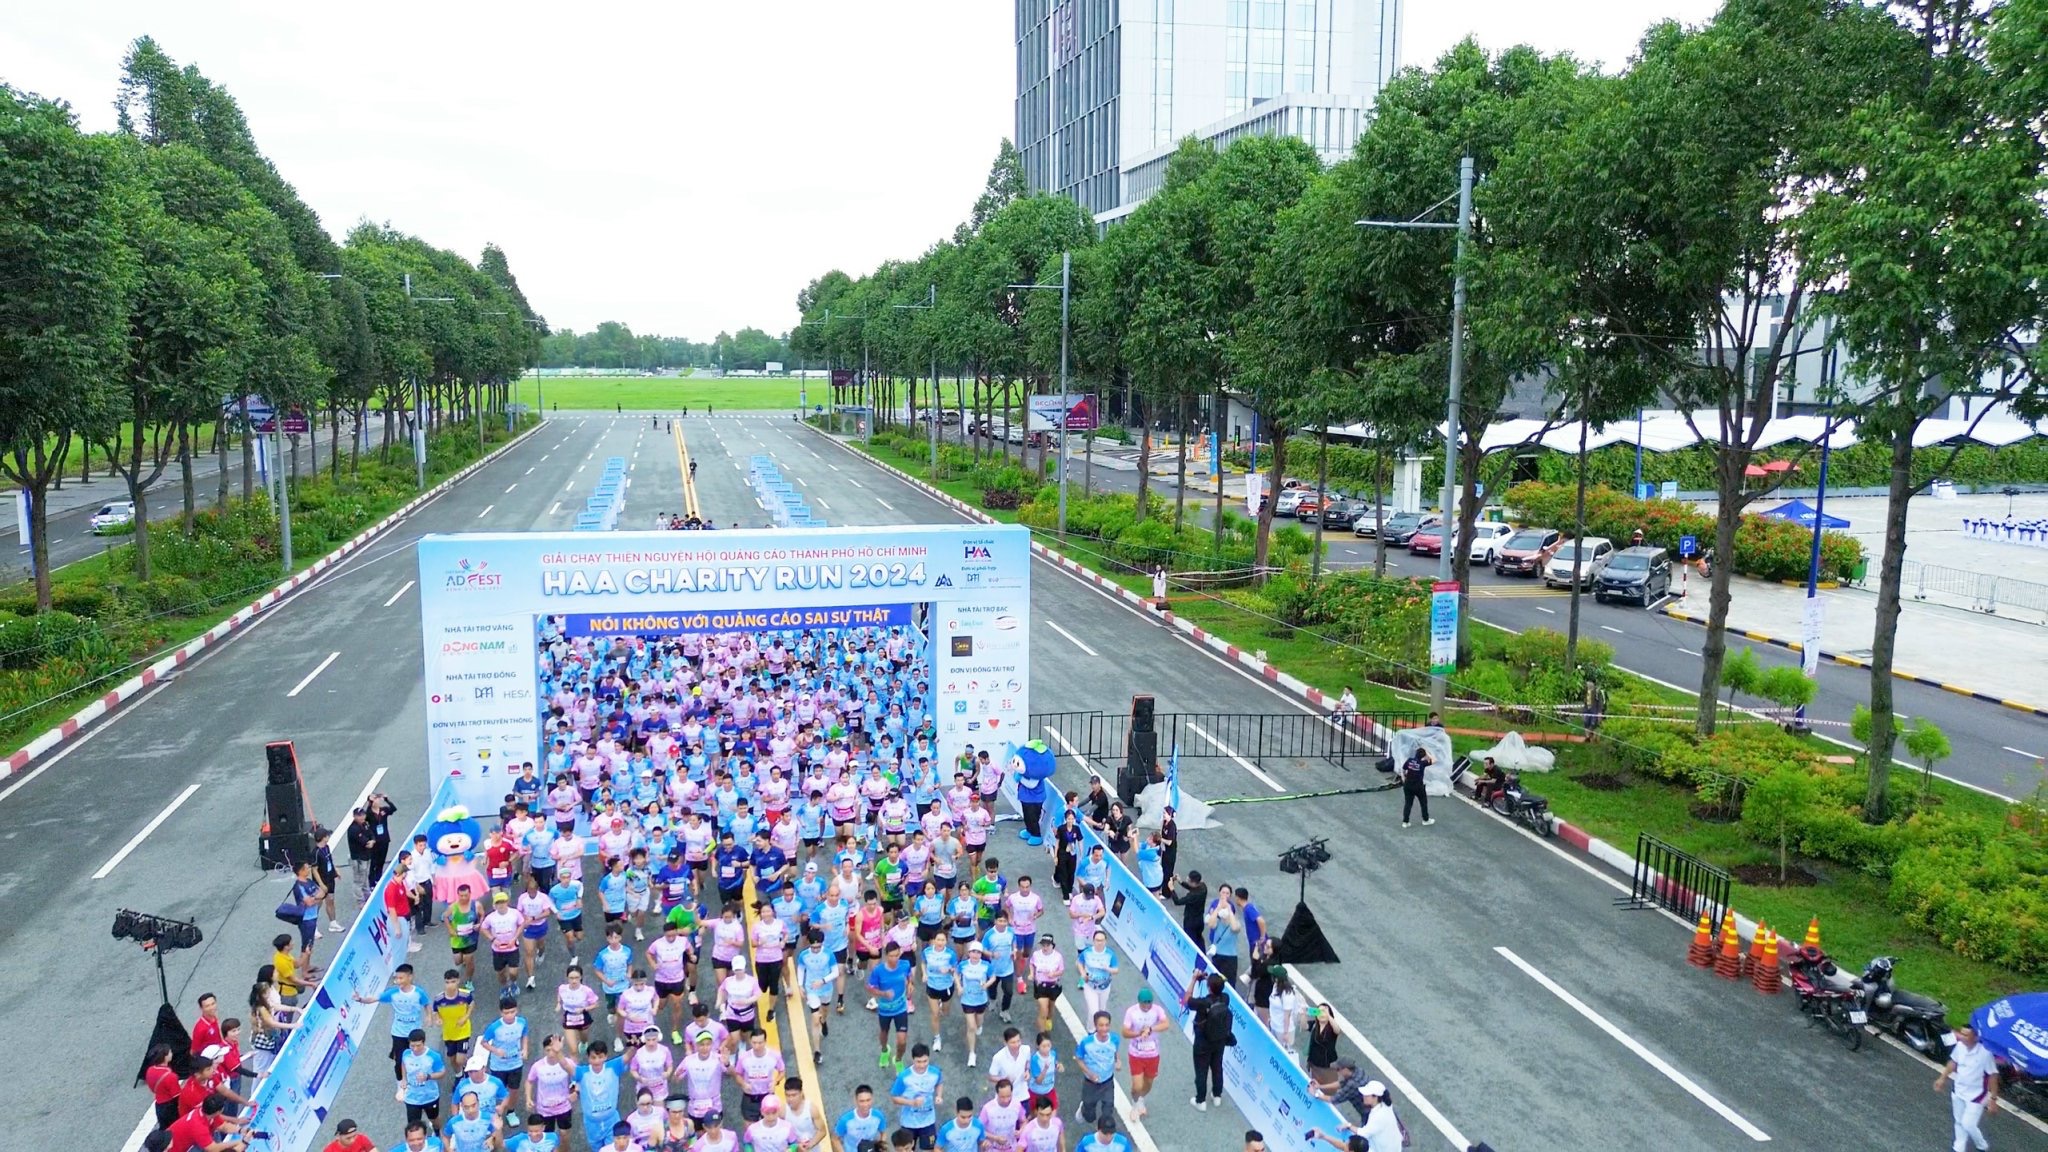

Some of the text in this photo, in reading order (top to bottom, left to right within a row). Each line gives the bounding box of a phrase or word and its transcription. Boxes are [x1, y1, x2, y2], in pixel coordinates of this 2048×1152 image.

[1684, 540, 1691, 549] P
[570, 553, 602, 565] CHẠY
[696, 550, 716, 562] HỘI
[719, 549, 760, 561] QUẢNG
[763, 548, 787, 560] CÁO
[876, 546, 895, 557] CHÍ
[898, 547, 927, 556] MINH
[543, 561, 927, 596] HAA CHARITY RUN 2024
[590, 607, 891, 631] NÓI KHÔNG VỚI QUẢNG CÁO SAI SỰ THẬT
